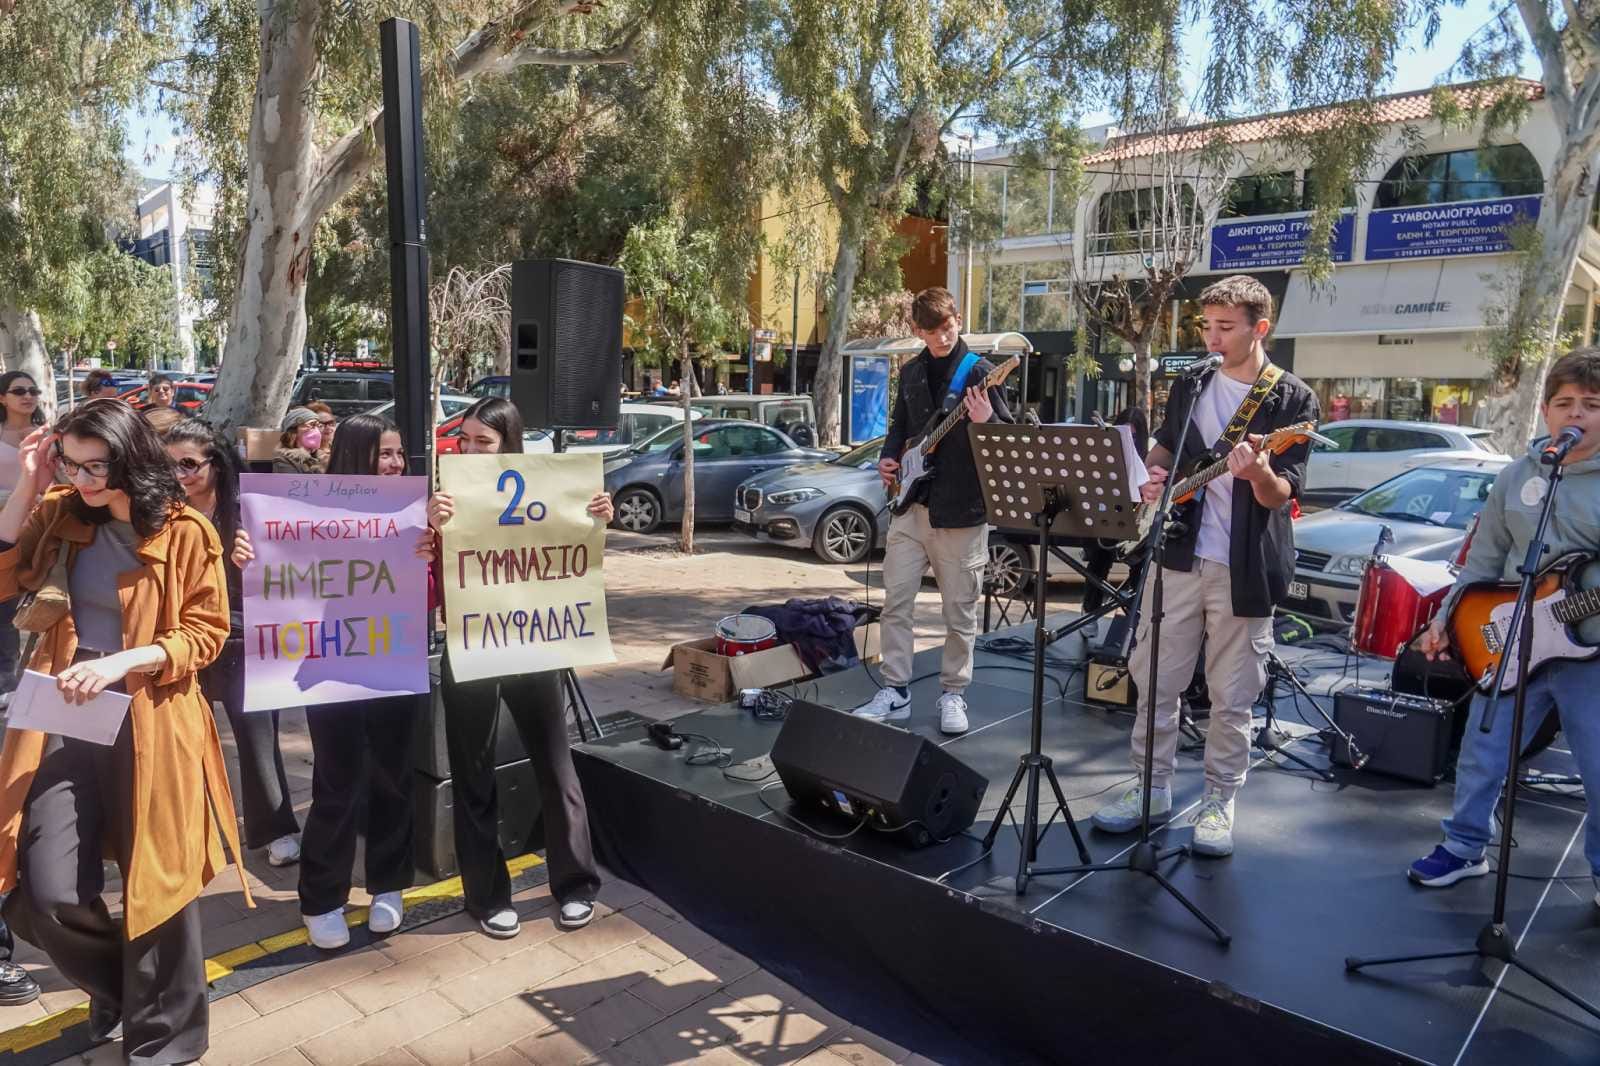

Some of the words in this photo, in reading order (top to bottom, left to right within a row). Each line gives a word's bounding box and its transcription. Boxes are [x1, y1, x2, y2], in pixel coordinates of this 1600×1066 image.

[1392, 203, 1513, 224] ΣΥΜΒΟΛΑΙΟΓΡΑΦΕΙΟ
[1422, 221, 1449, 230] NOTARY
[1451, 218, 1477, 227] PUBLIC
[1228, 224, 1286, 237] ΔΙΚΗΓΟΡΙΚΟ
[1275, 233, 1299, 241] OFFICE
[265, 517, 400, 541] ΠΑΓΚΟΣΜΙΑ
[457, 543, 588, 589] ΓΥΜΝΑΣΙΟ
[262, 559, 397, 600] ΗΜΕΡΑ
[1291, 582, 1306, 596] 189
[254, 613, 417, 661] ΠΟΙΗΣΗΣ
[462, 602, 596, 650] ΓΛΥΦΑΔΑΣ
